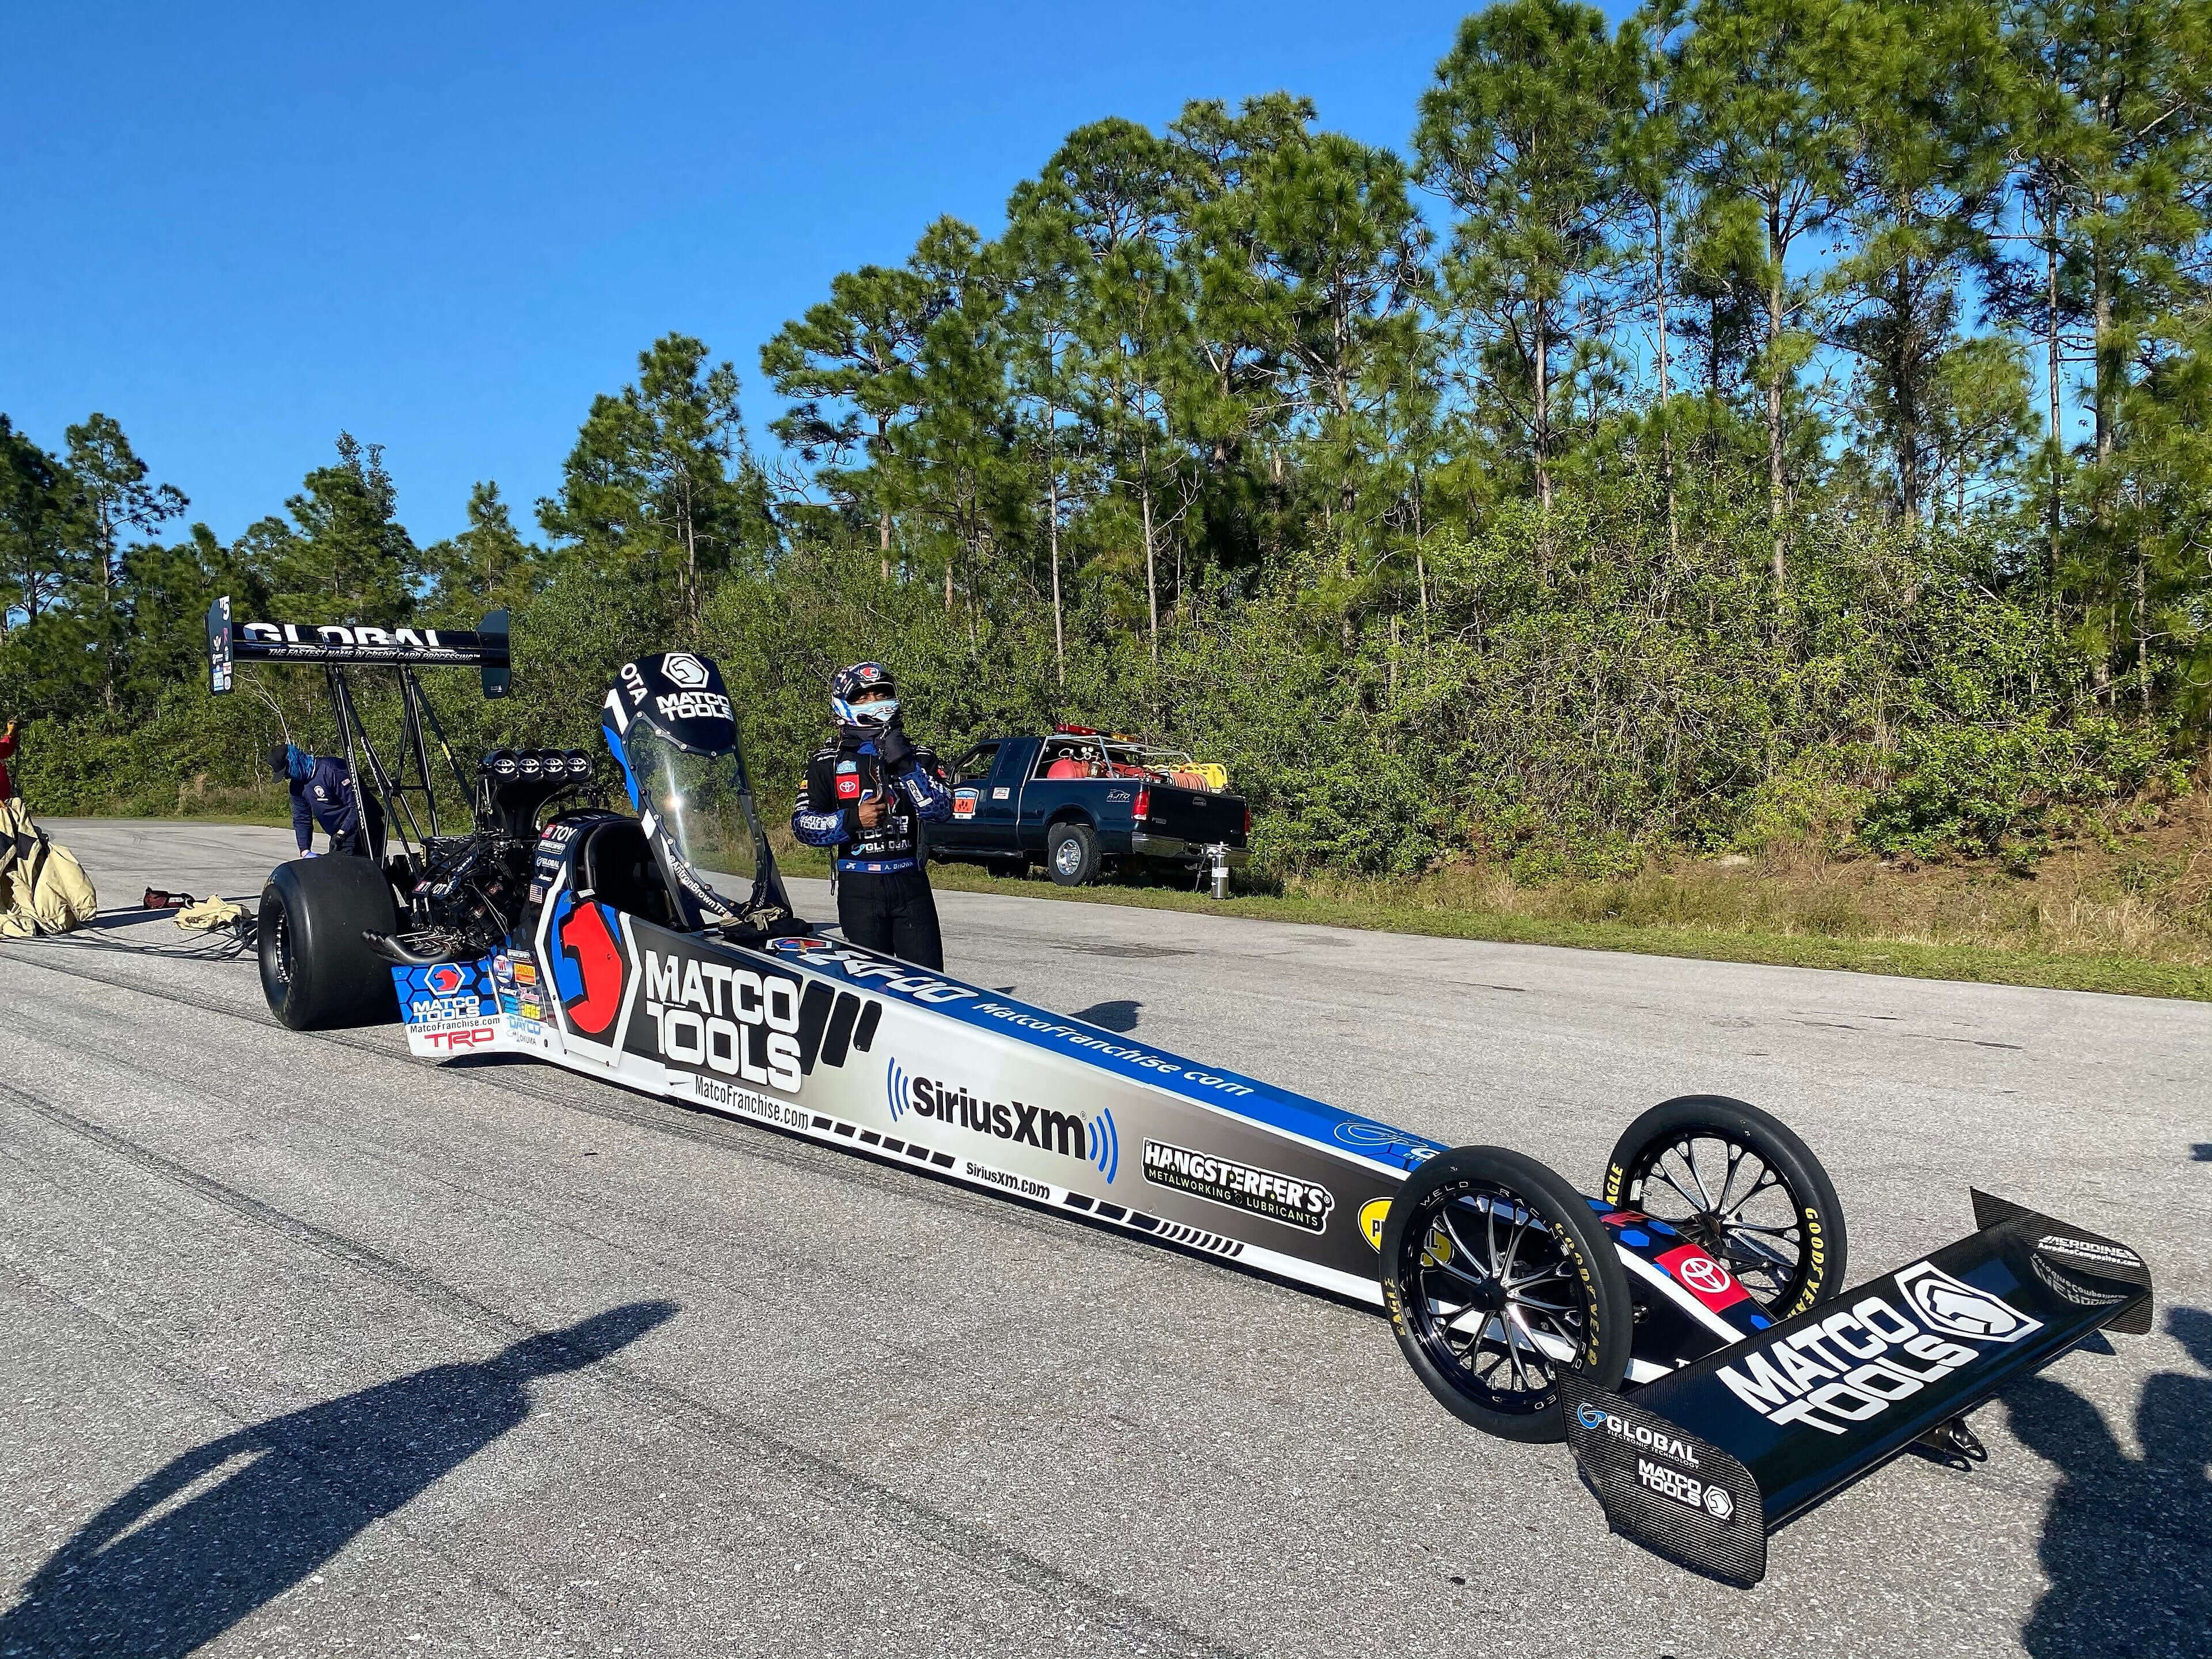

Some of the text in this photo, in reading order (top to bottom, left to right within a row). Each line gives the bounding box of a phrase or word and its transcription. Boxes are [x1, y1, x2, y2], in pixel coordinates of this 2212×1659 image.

[243, 622, 455, 652] GLOBAL
[327, 650, 353, 658] NAME
[365, 650, 397, 659] CREDIT
[397, 652, 421, 660] CARD
[656, 692, 730, 711] MATCO
[660, 704, 734, 722] TOOLS
[551, 825, 578, 842] TOY
[645, 949, 800, 1035] MATCO
[797, 950, 979, 1003] MATCO
[412, 995, 480, 1013] MATCO
[413, 1006, 480, 1024] TOOLS
[410, 1017, 500, 1034] MatcoFranchise.com
[424, 1028, 494, 1050] TRD
[646, 1000, 802, 1093] TOOLS
[695, 1075, 808, 1130] MatcoFranchise.com
[1149, 1168, 1319, 1226] METALWORKING LUBRICANTS
[1420, 1181, 1469, 1207] WELD
[1606, 1162, 1624, 1207] AGLE
[1384, 1275, 1407, 1337] EAGLE
[1555, 1222, 1600, 1366] GOODYEAR
[1715, 1296, 1919, 1415] MATCO
[1766, 1334, 1979, 1435] TOOLS
[1607, 1415, 1699, 1465] GLOBAL
[1607, 1429, 1699, 1469] ELECTRONIC TECHNOLOGY
[1638, 1459, 1702, 1495] MATCO
[1638, 1469, 1701, 1507] TOOLS
